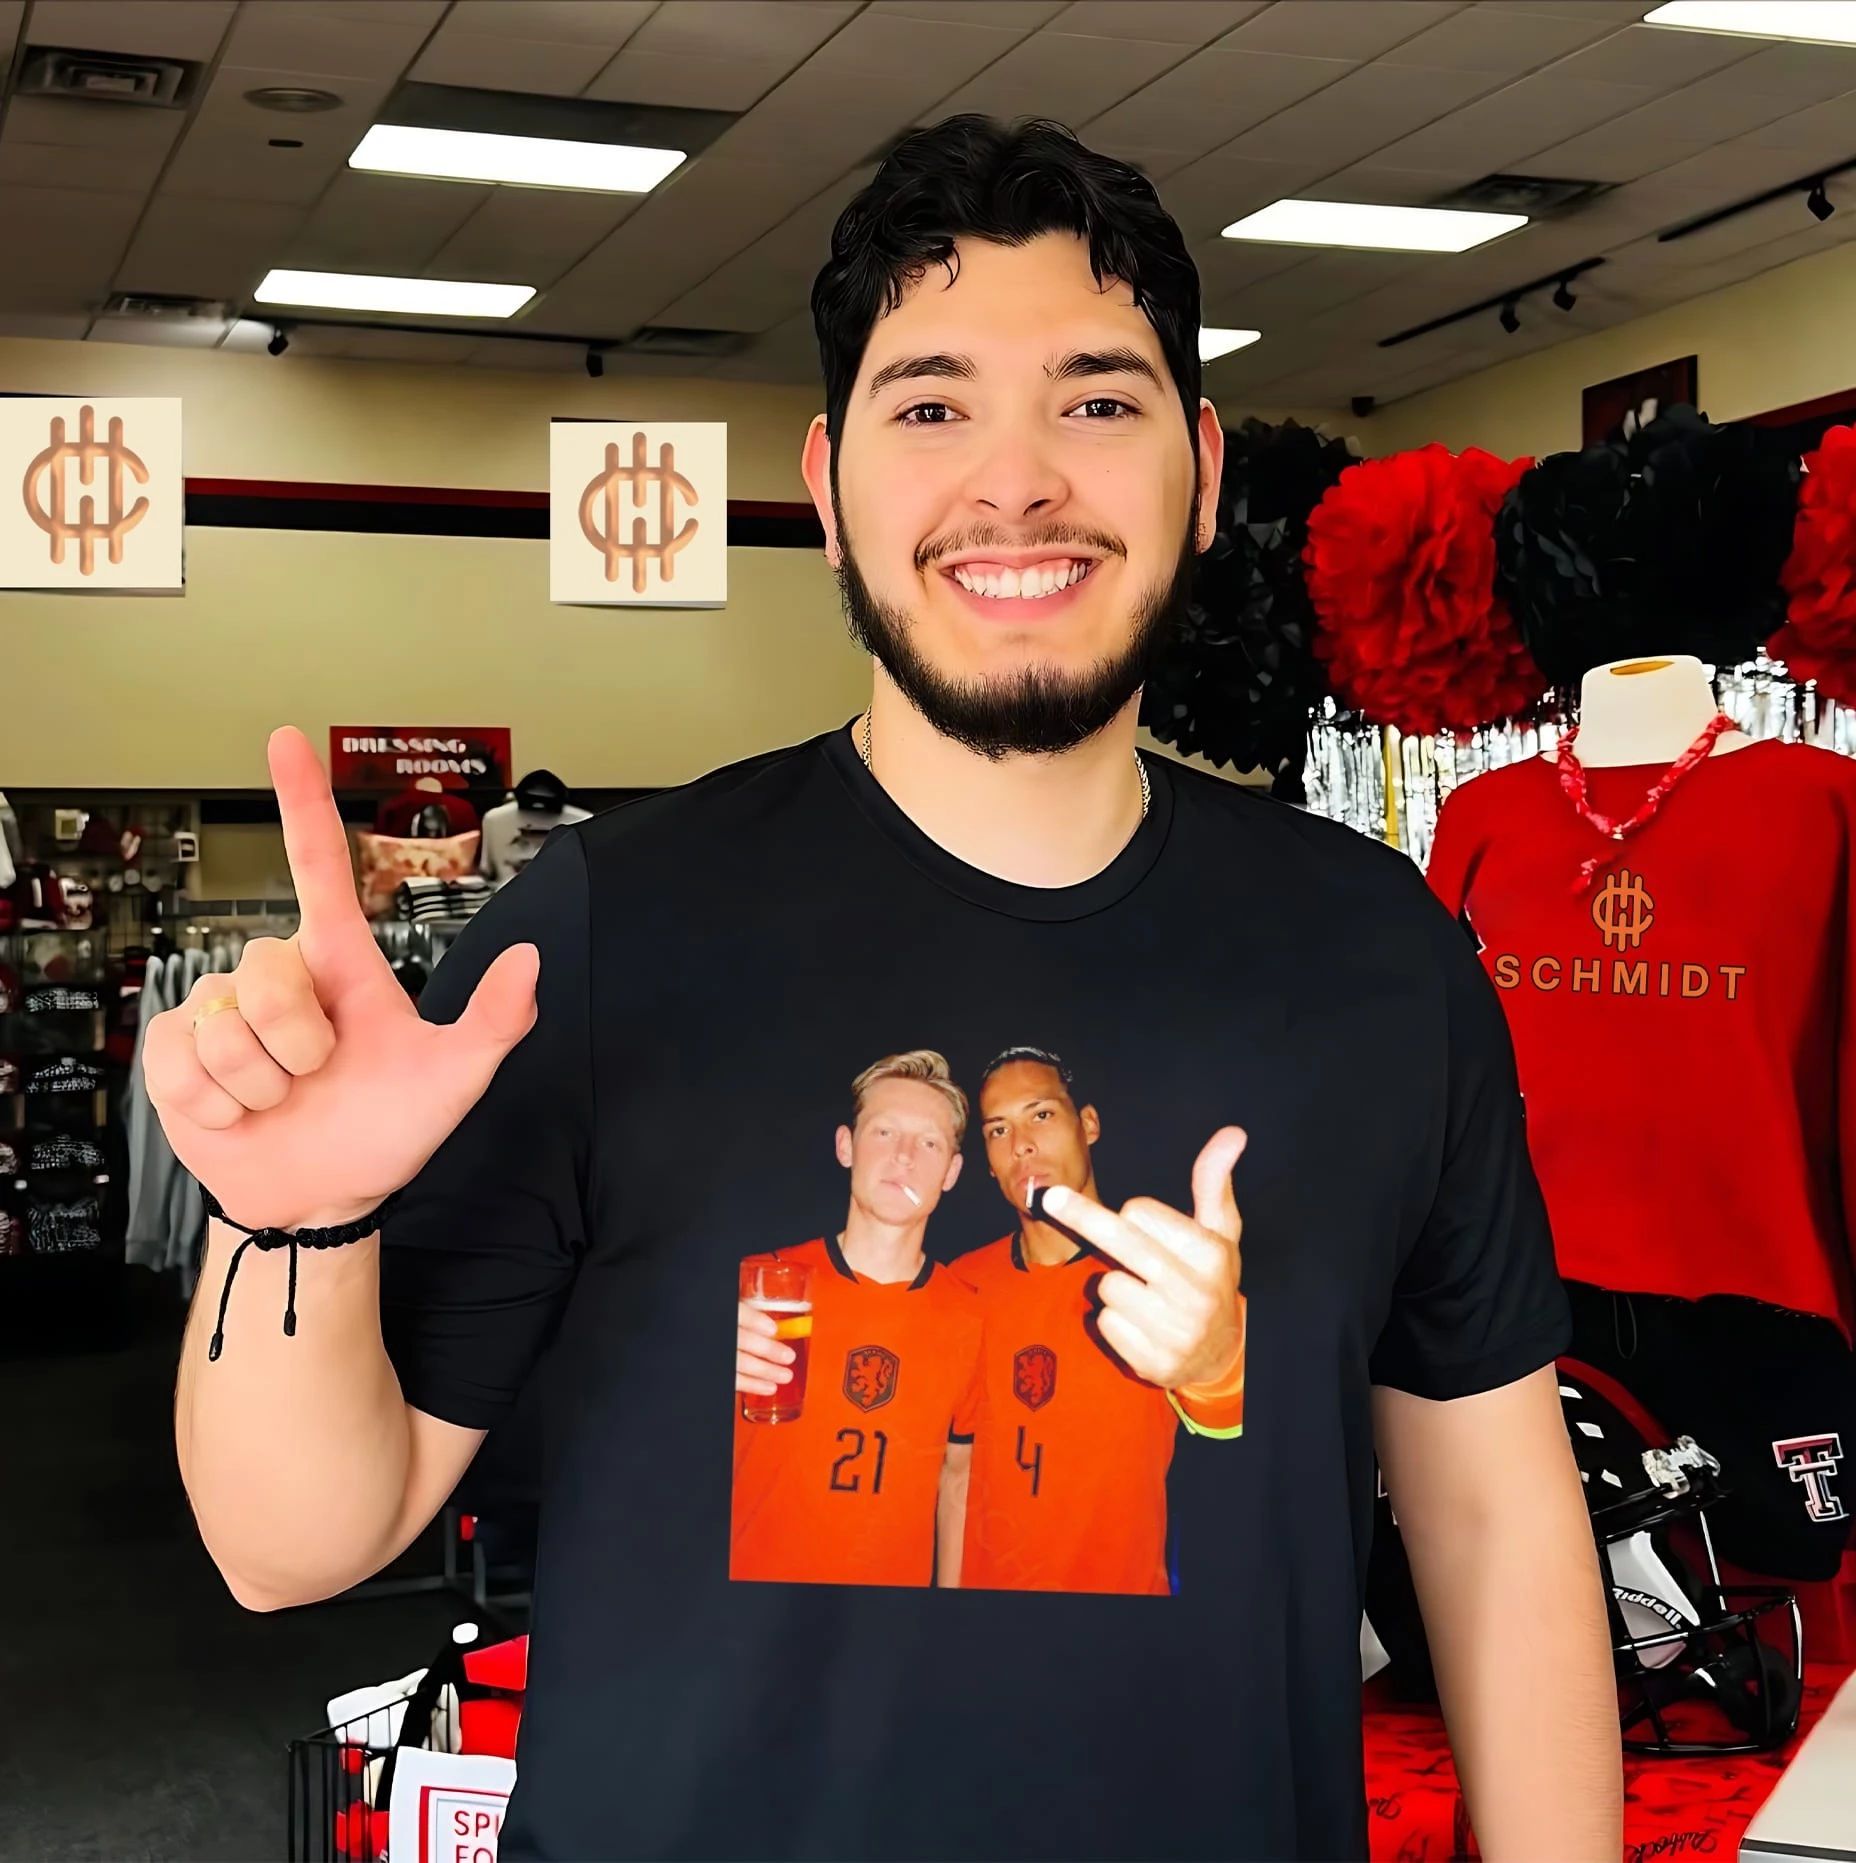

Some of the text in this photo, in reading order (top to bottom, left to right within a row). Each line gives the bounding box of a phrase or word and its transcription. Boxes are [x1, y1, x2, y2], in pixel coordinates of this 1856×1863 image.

[1493, 953, 1747, 1000] SCHMIDT
[829, 1426, 888, 1494] 21
[1015, 1425, 1044, 1498] 4
[1612, 1587, 1682, 1626] Riddell
